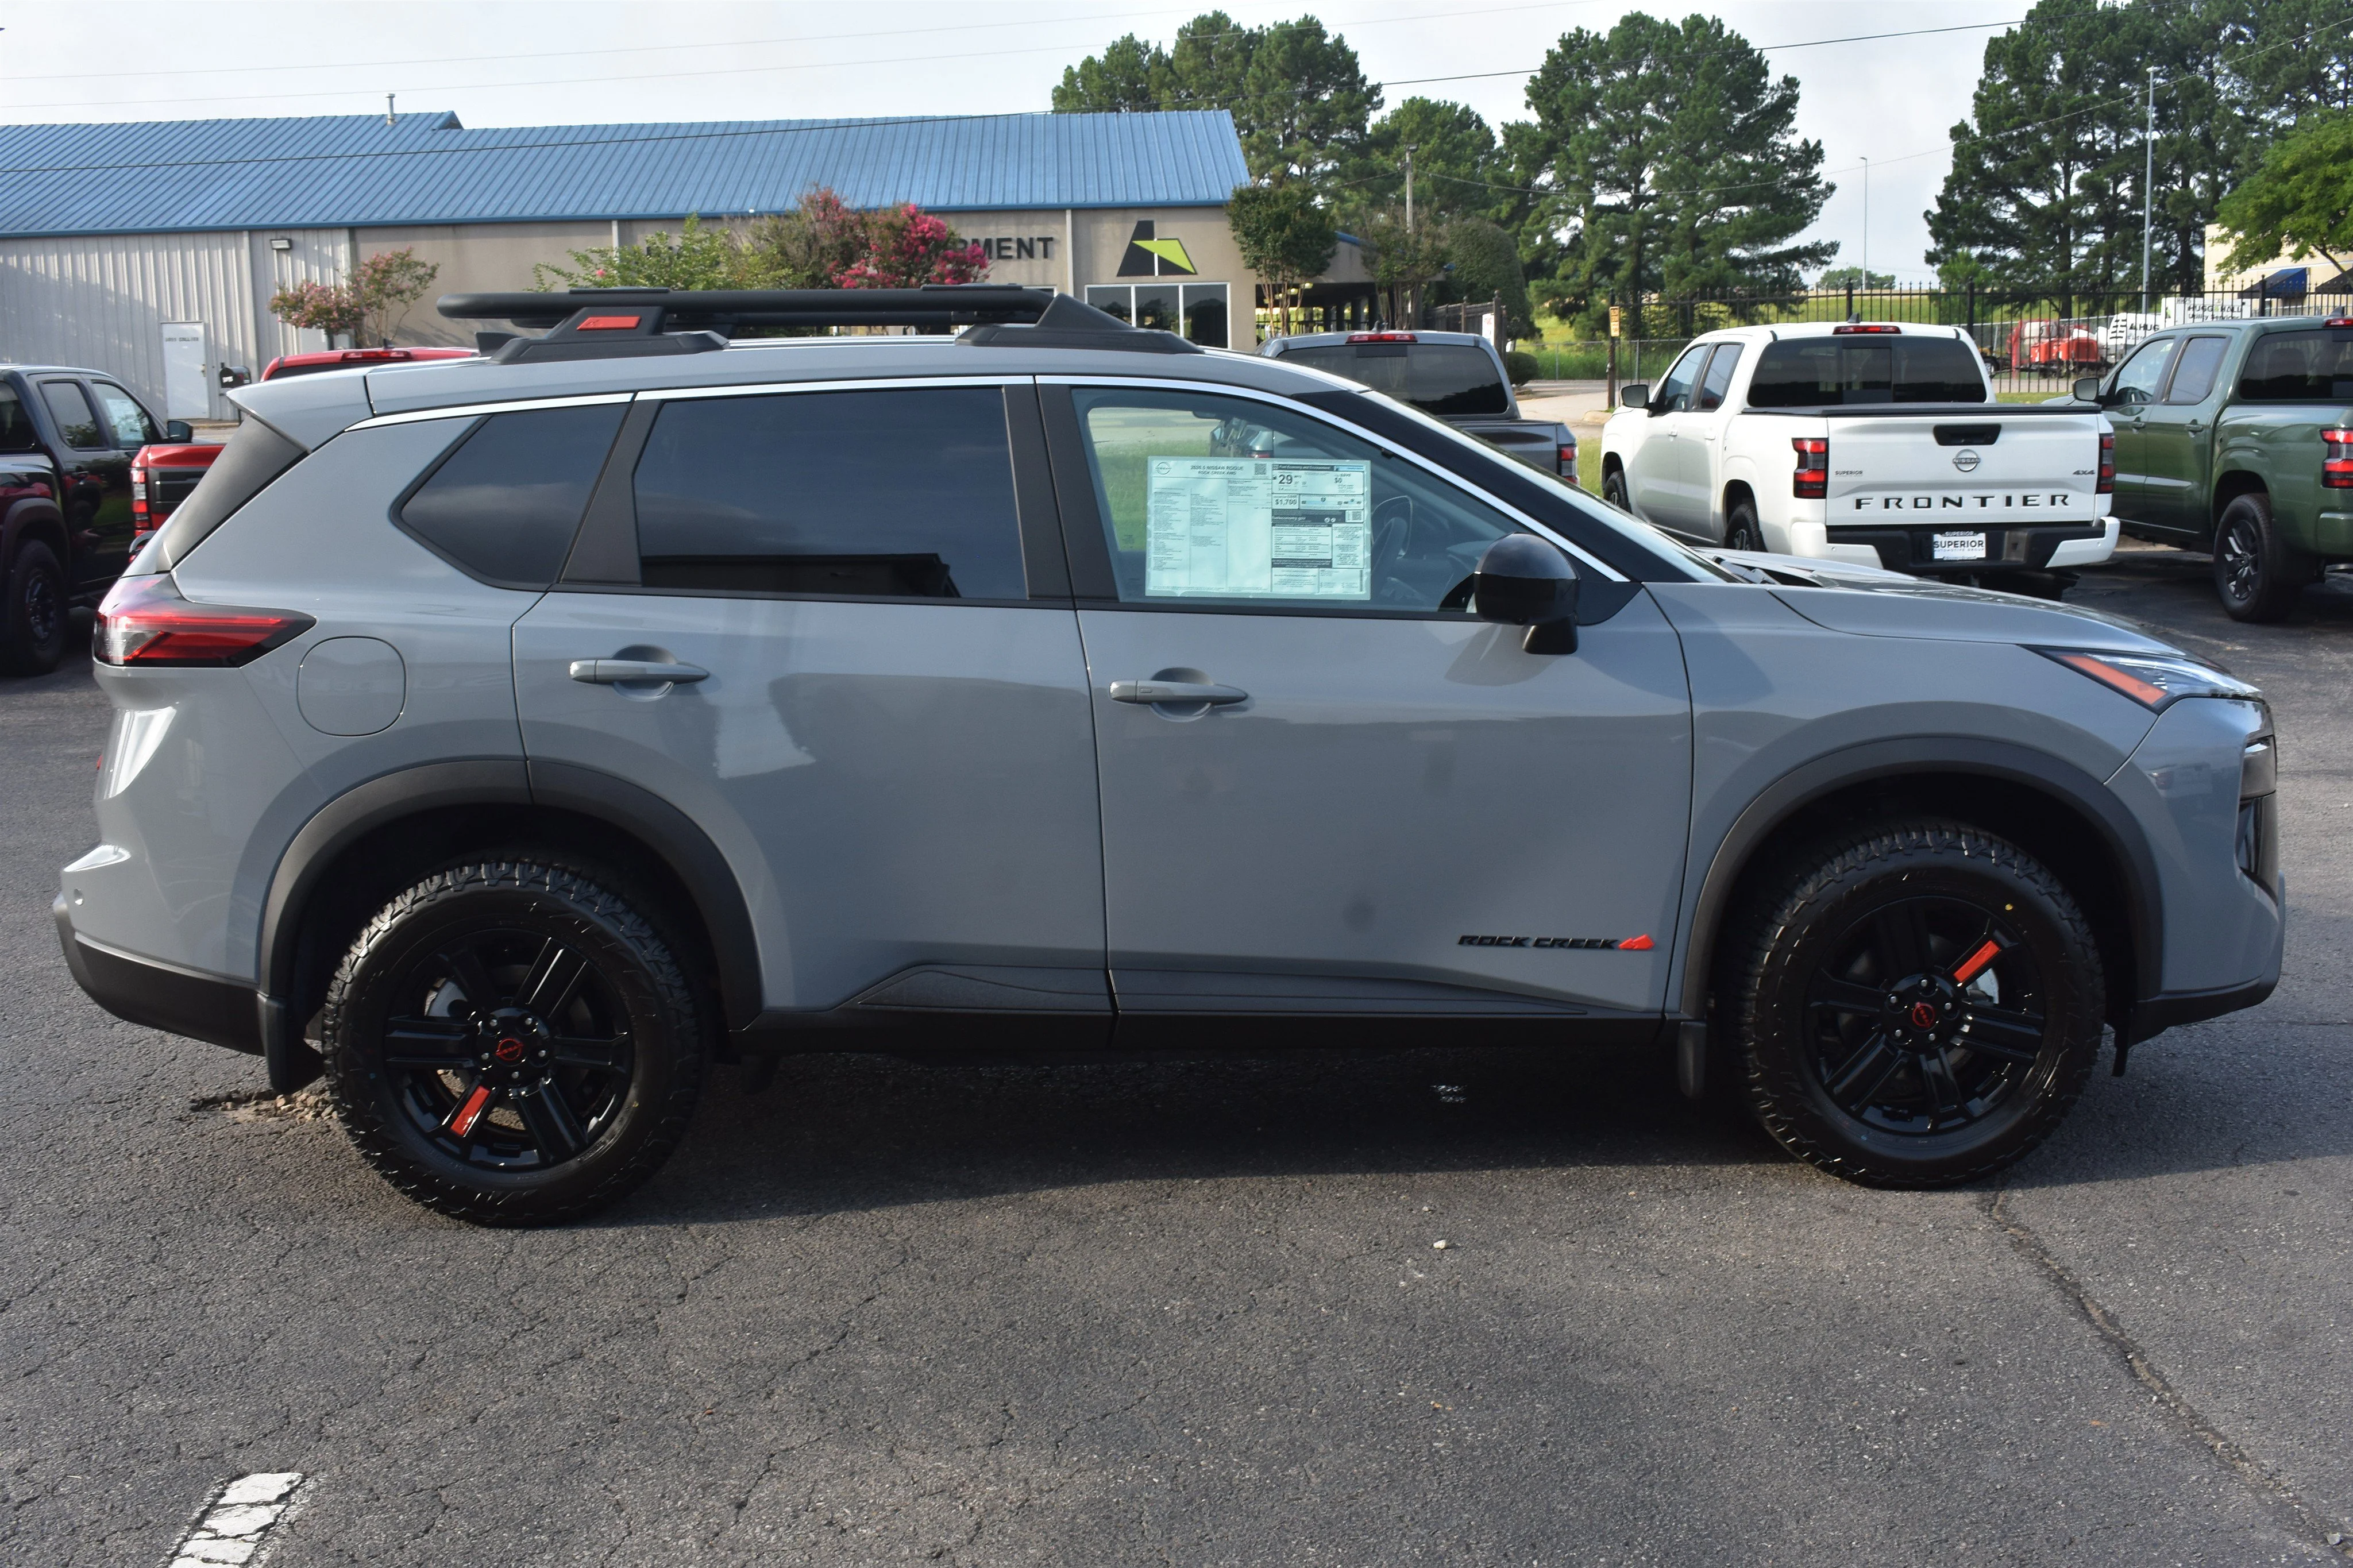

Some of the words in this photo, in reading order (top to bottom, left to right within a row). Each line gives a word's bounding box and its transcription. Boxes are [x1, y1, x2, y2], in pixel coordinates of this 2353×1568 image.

[1278, 474, 1293, 485] 29
[1854, 495, 2069, 510] FRONTIER
[1933, 540, 1984, 549] SUPERIOR
[1457, 934, 1531, 947] ROCK
[1532, 936, 1619, 949] CREEK
